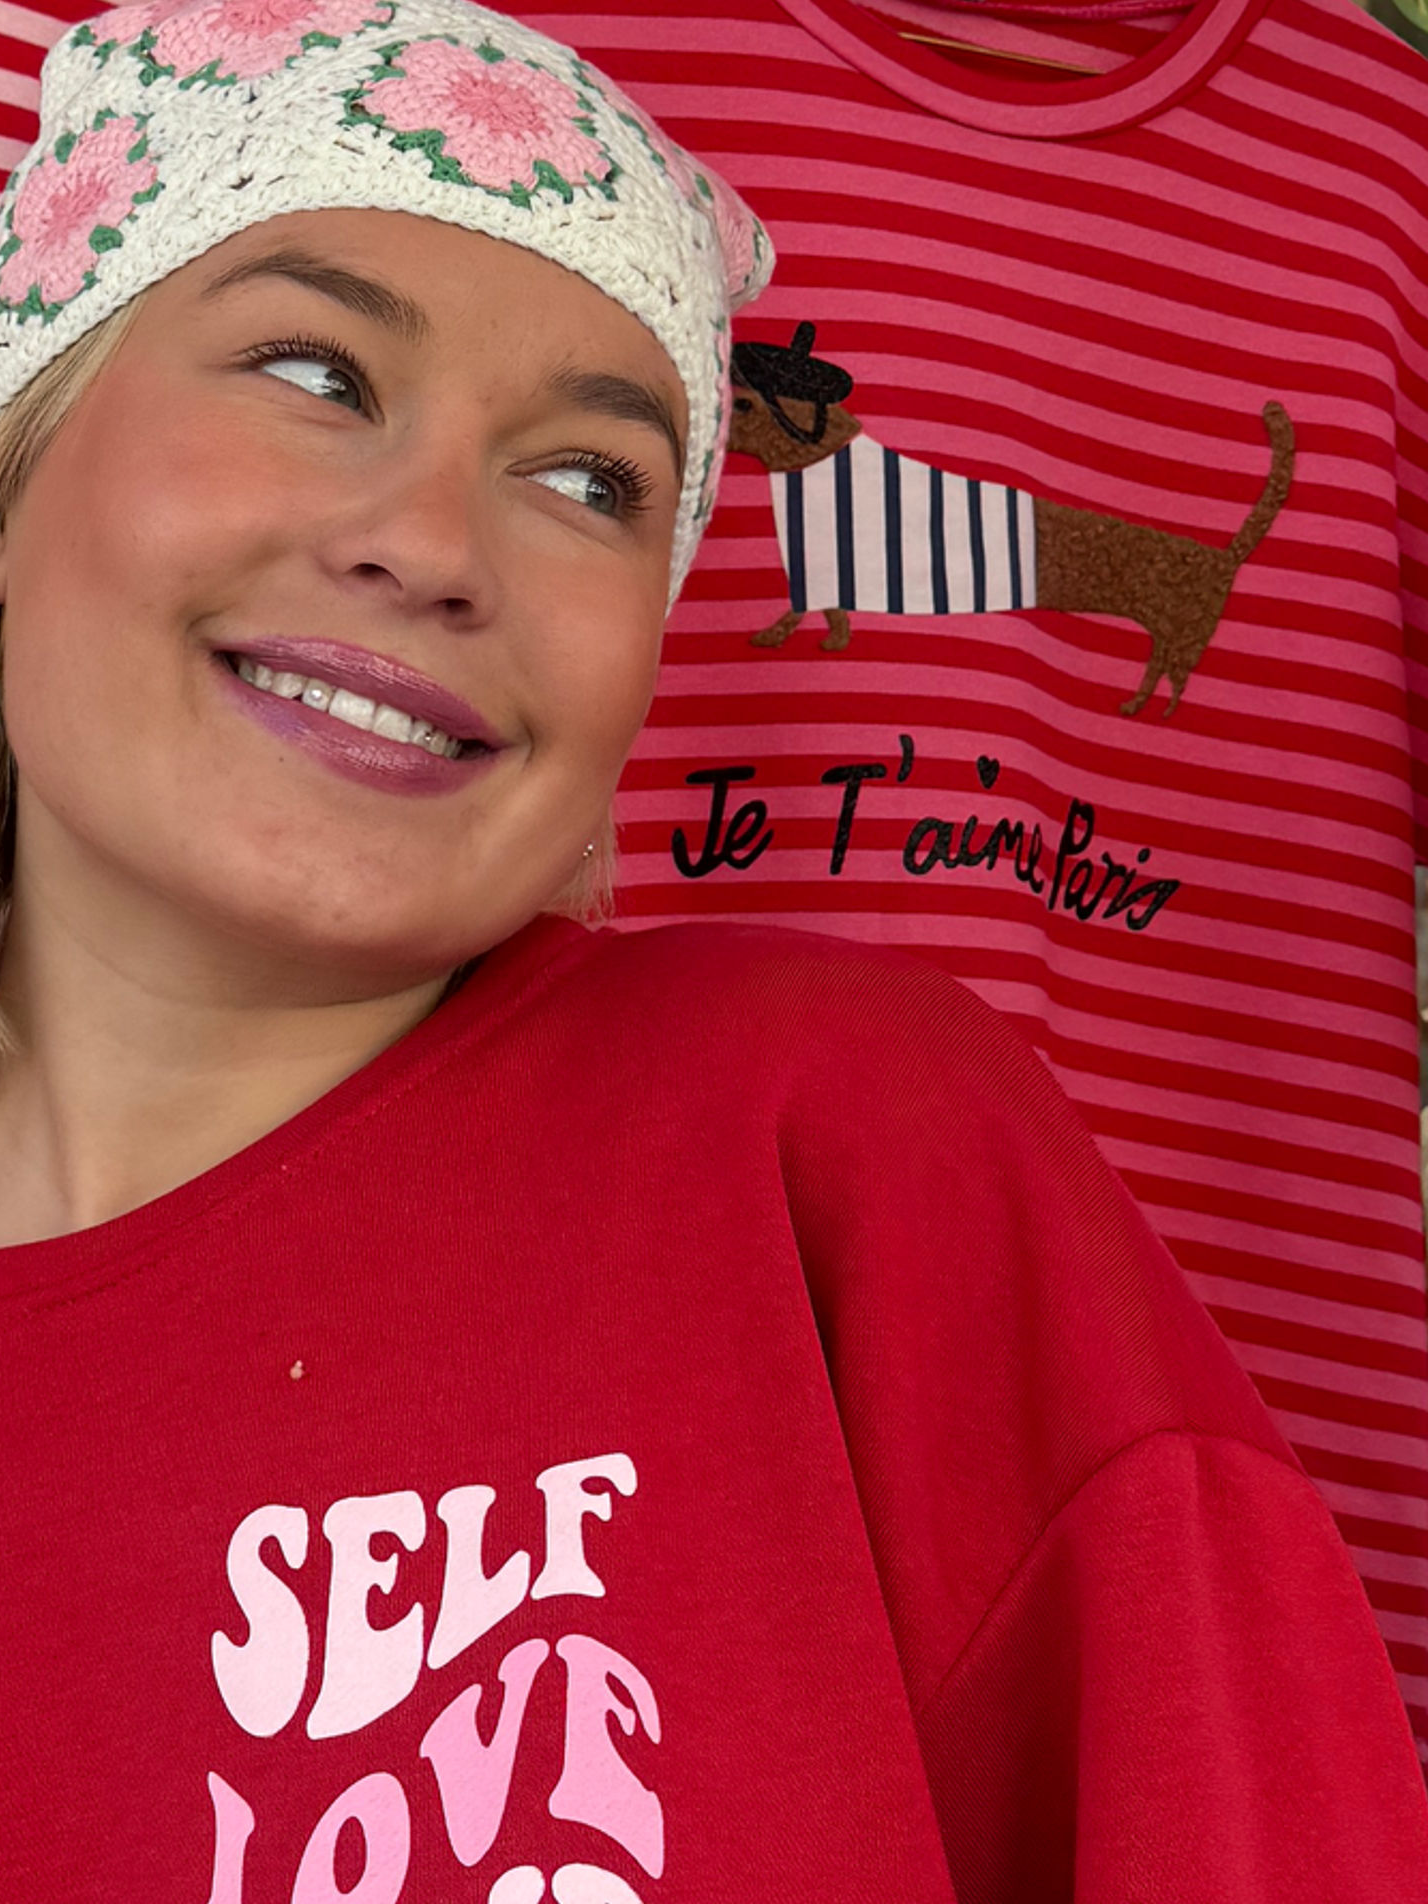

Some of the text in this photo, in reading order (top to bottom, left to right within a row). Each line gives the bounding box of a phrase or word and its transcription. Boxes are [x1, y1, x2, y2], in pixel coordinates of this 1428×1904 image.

[672, 733, 1181, 931] Je T'aime Paris
[211, 1452, 638, 1740] SELF
